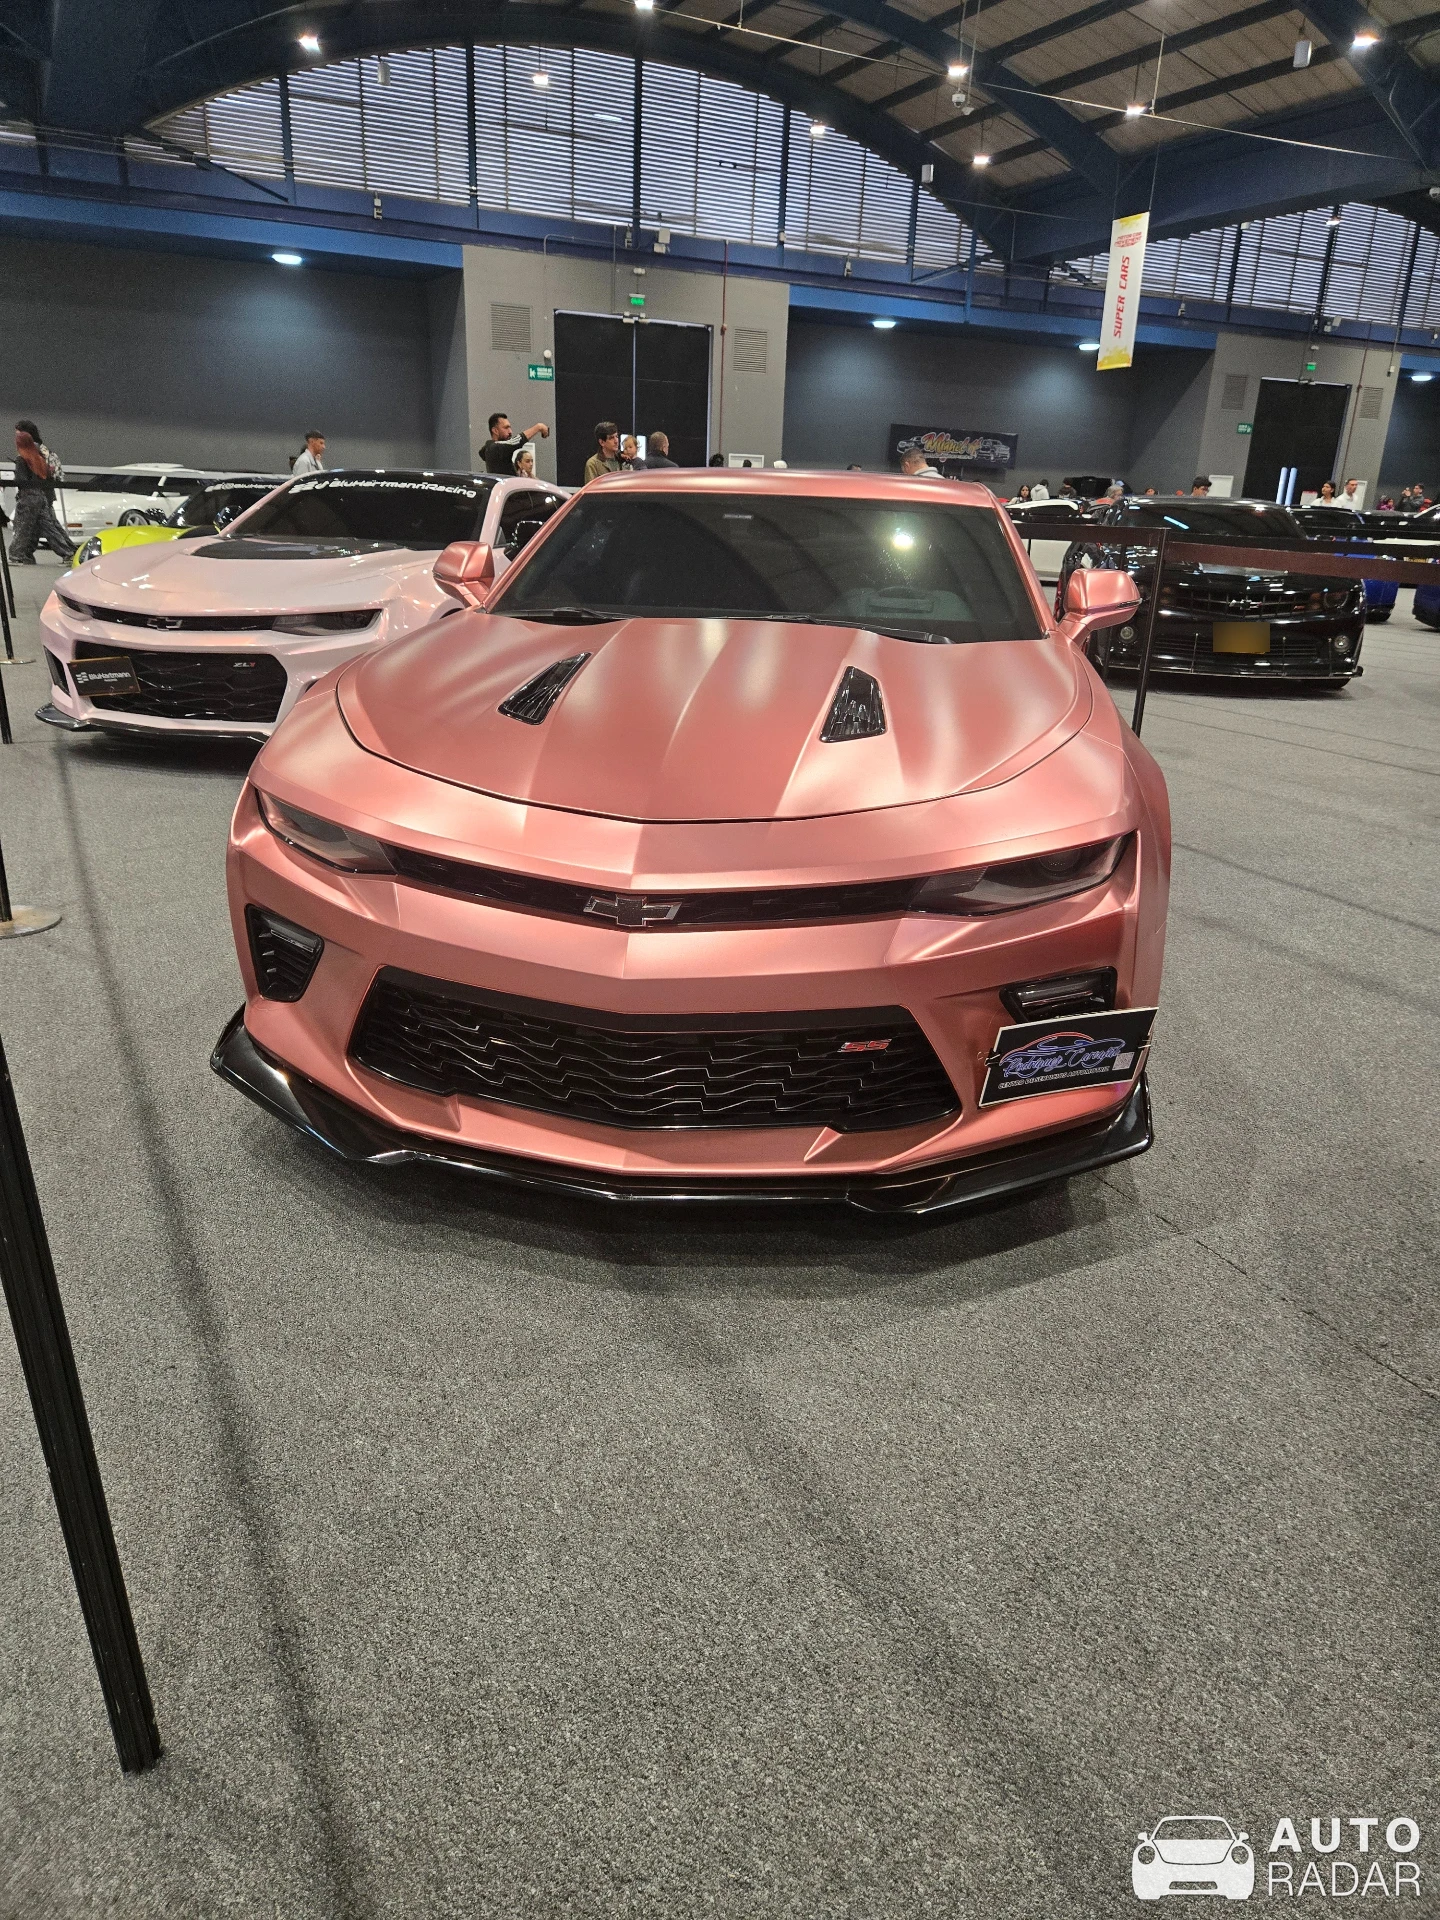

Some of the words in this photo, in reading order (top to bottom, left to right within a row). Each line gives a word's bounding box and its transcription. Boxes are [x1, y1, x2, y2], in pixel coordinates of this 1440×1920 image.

[1118, 255, 1130, 290] CARS
[1113, 295, 1125, 338] SUPER
[837, 1039, 892, 1052] SS
